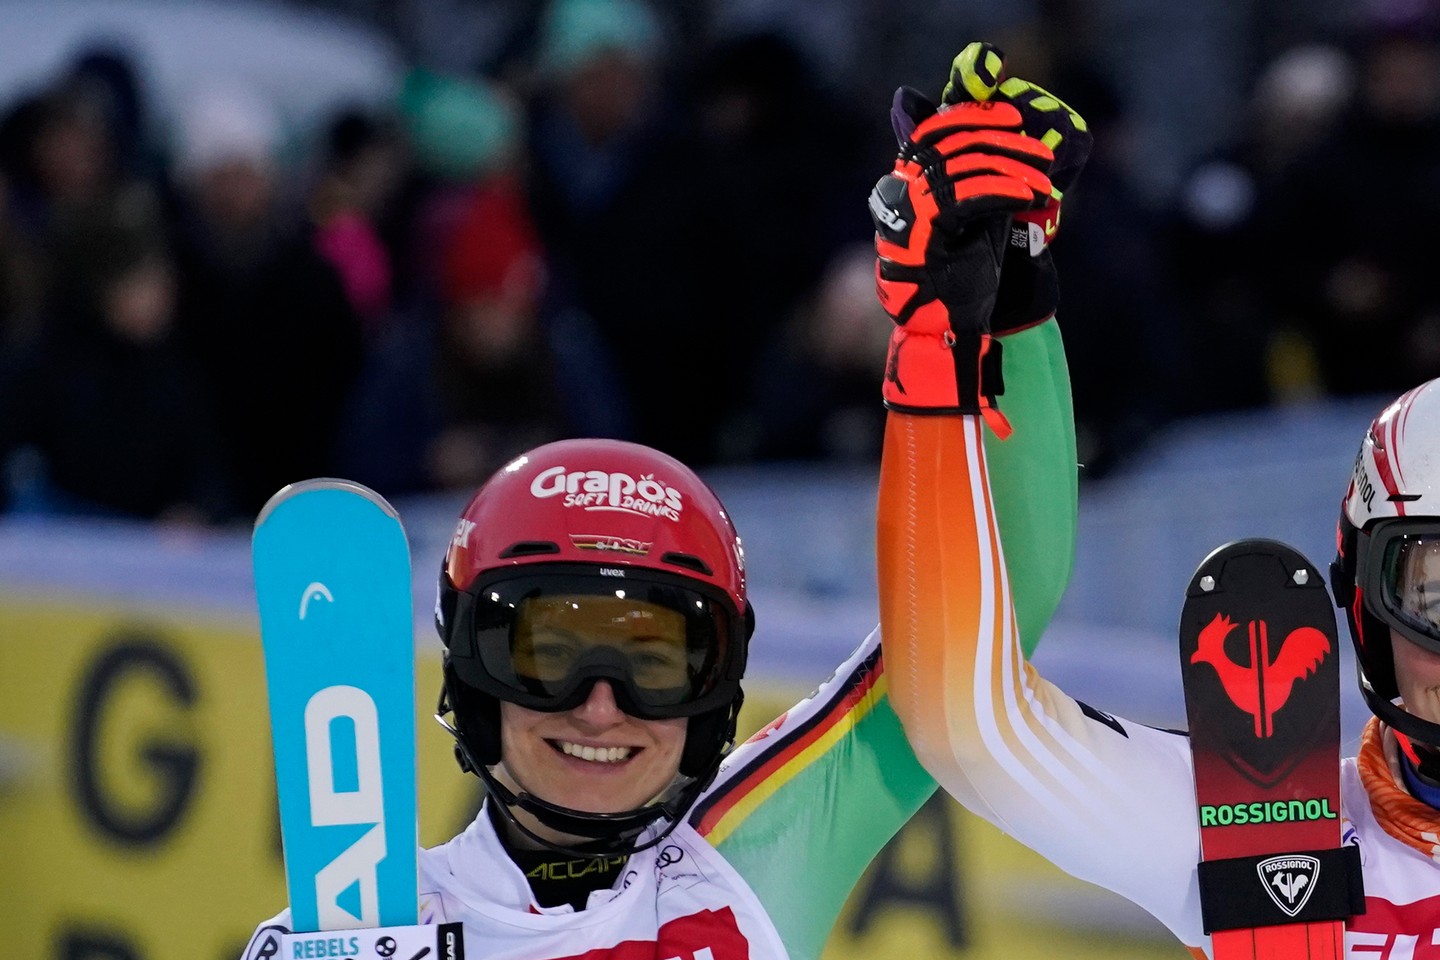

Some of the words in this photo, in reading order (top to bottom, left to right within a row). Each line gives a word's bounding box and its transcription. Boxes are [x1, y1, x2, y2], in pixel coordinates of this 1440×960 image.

[562, 489, 613, 508] SOFT
[620, 493, 681, 524] DRINKS
[599, 567, 626, 578] uvex
[1200, 798, 1338, 828] ROSSIGNOL
[1264, 860, 1313, 873] ROSSIGNOL
[292, 936, 360, 960] REBELS
